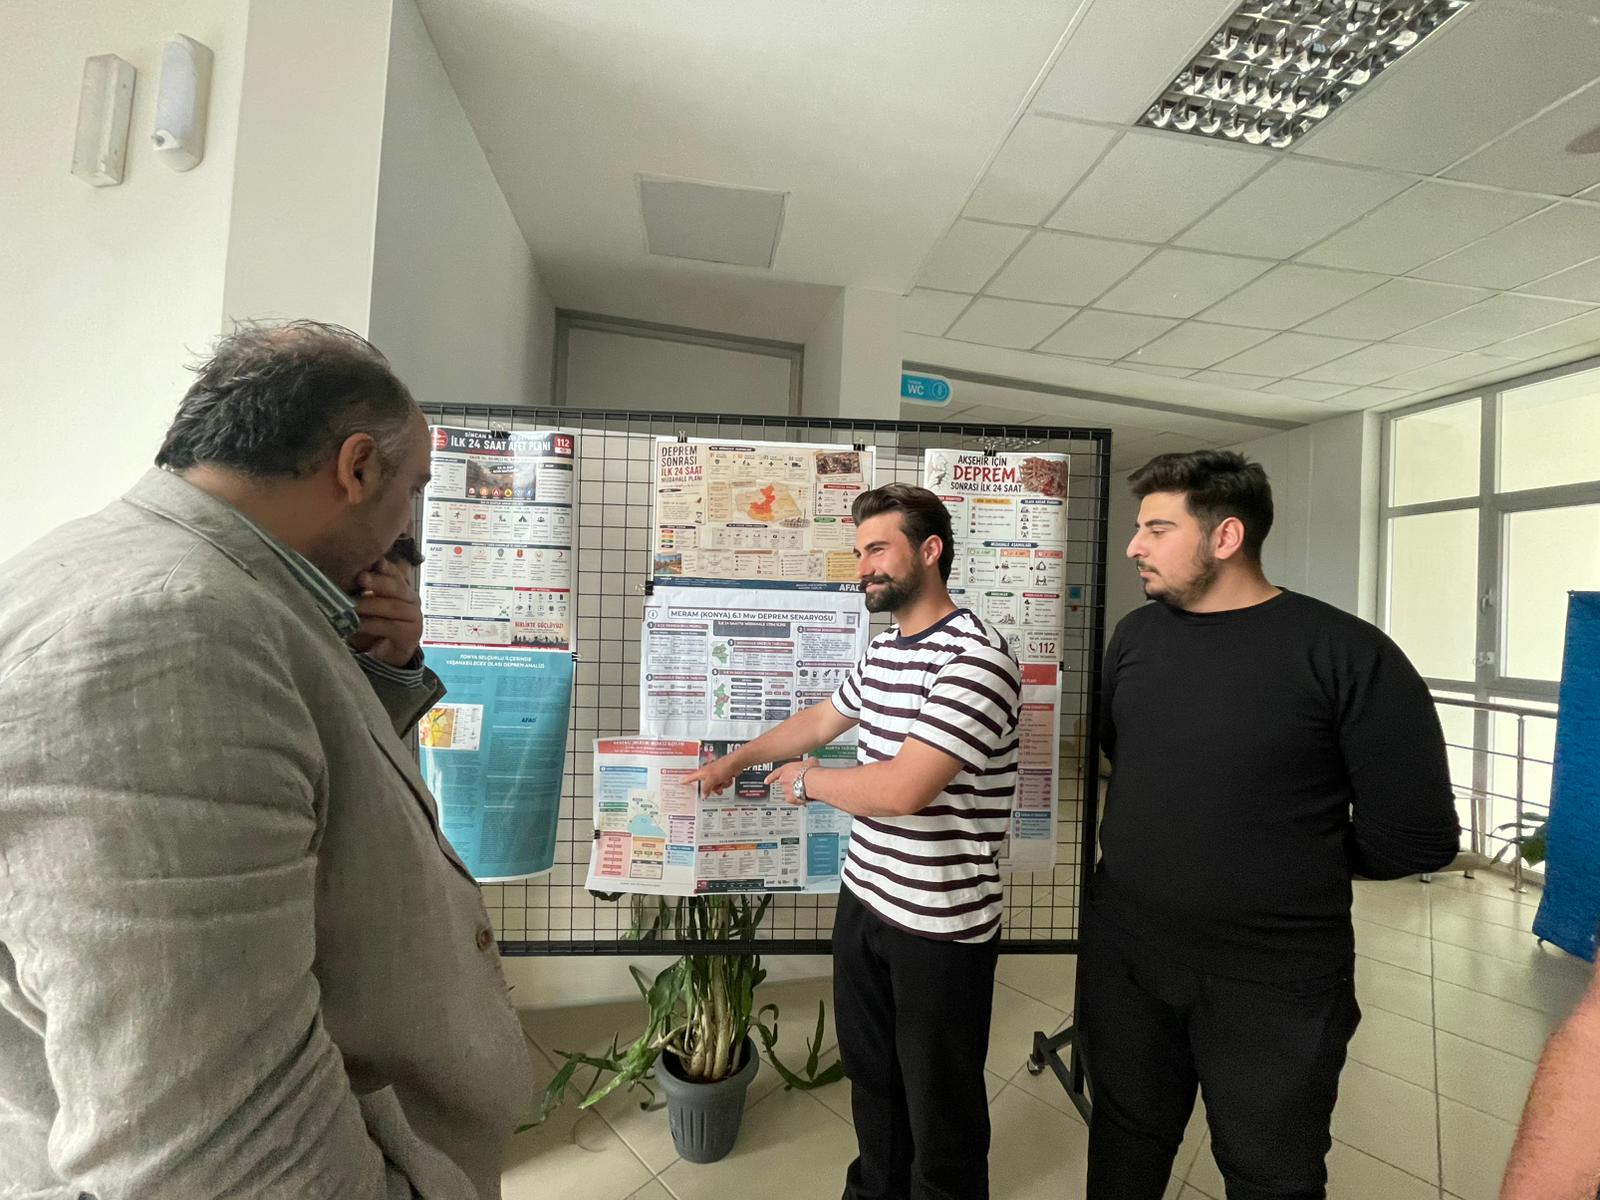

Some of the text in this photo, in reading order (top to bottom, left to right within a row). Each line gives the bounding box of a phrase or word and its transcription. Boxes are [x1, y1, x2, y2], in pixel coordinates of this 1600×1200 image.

[908, 384, 924, 395] WC
[451, 435, 466, 447] İLK
[468, 438, 481, 448] 24
[484, 440, 506, 450] SAAT
[528, 441, 551, 451] PLANI
[557, 438, 570, 448] 112
[661, 446, 698, 457] DEPREM
[661, 456, 698, 467] SONRASI
[958, 455, 989, 467] AKŞEHİR
[661, 466, 673, 476] İLK
[675, 467, 683, 475] 24
[685, 465, 703, 475] SAAT
[953, 465, 1016, 483] DEPREM
[951, 482, 1022, 493] SONRASI İLK 24 SAAT
[700, 611, 731, 619] (KONYA)
[1039, 642, 1055, 653] 112
